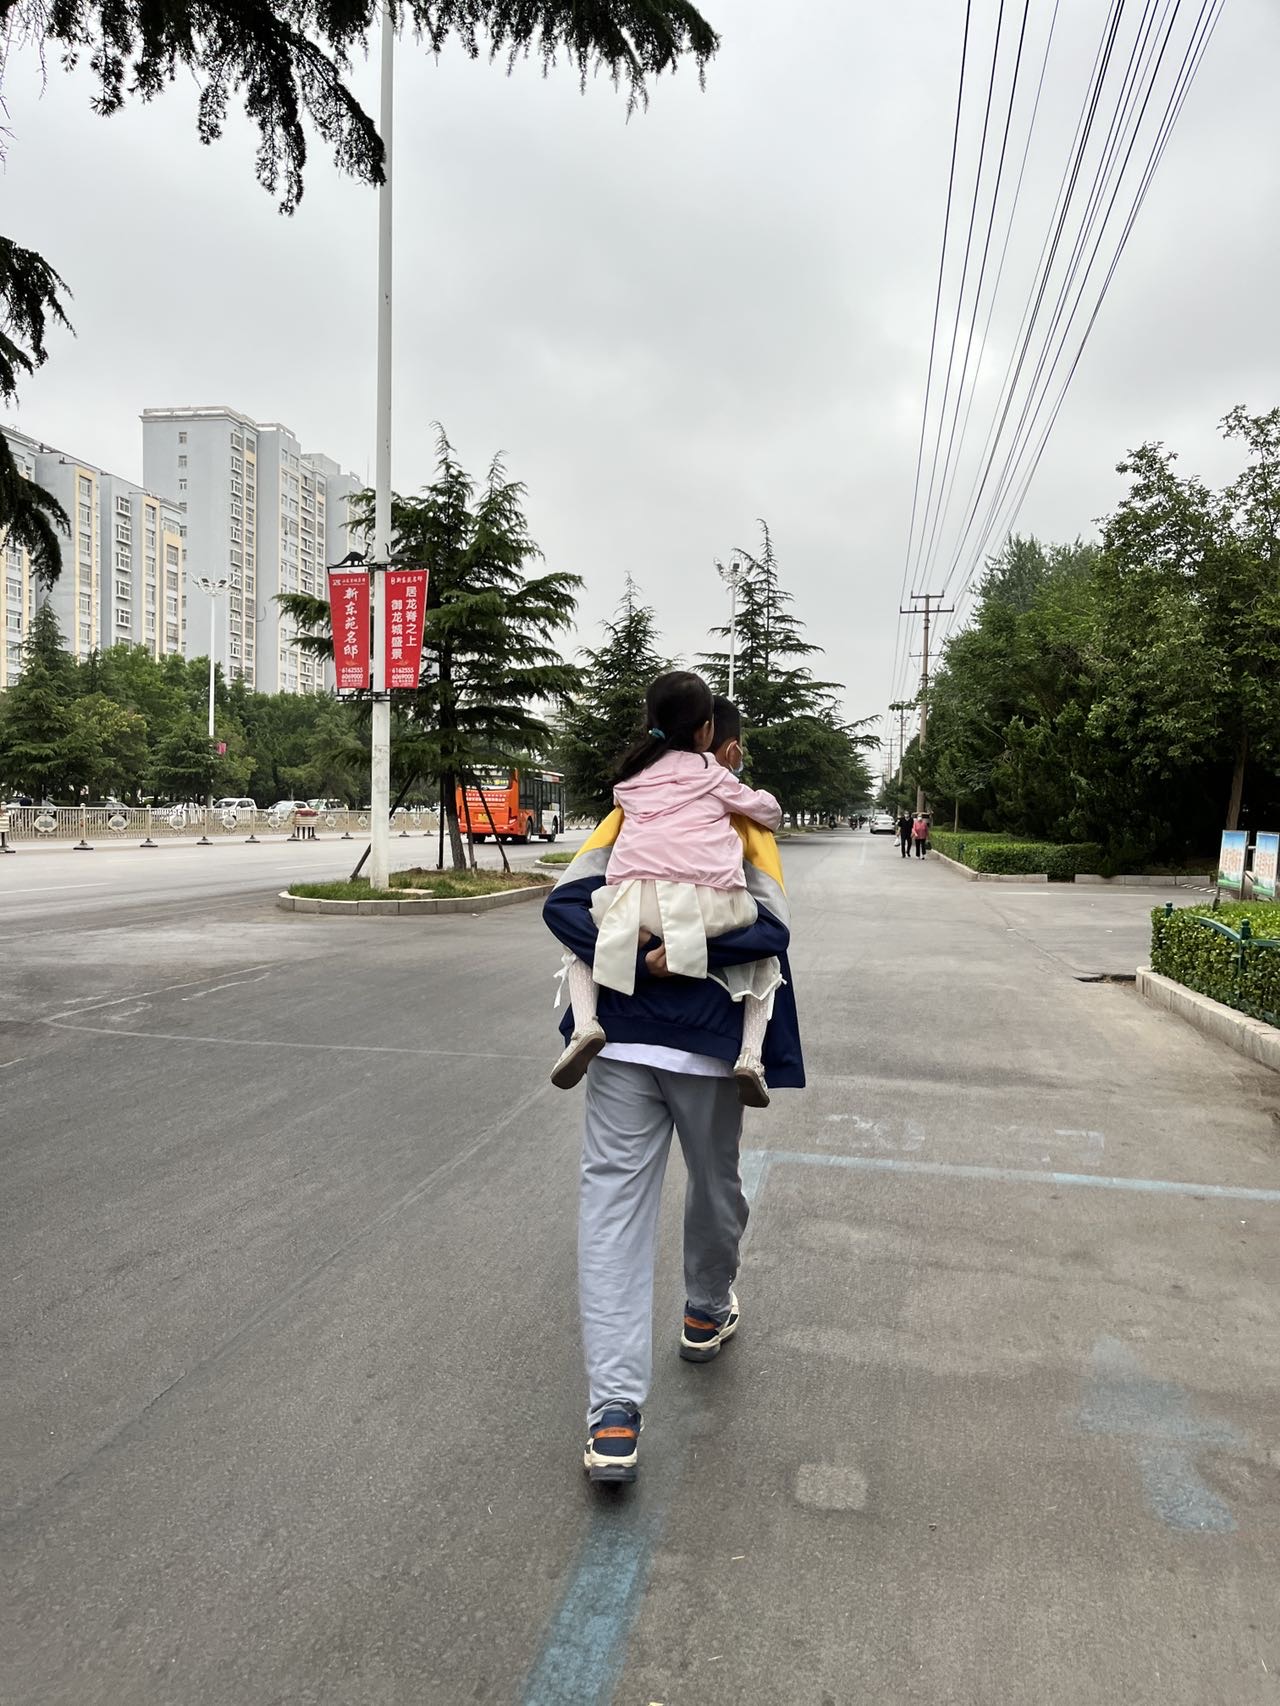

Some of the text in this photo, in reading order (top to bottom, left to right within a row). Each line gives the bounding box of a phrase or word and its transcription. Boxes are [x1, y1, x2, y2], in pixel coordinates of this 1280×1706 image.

[343, 587, 359, 659] 新东苑名邸
